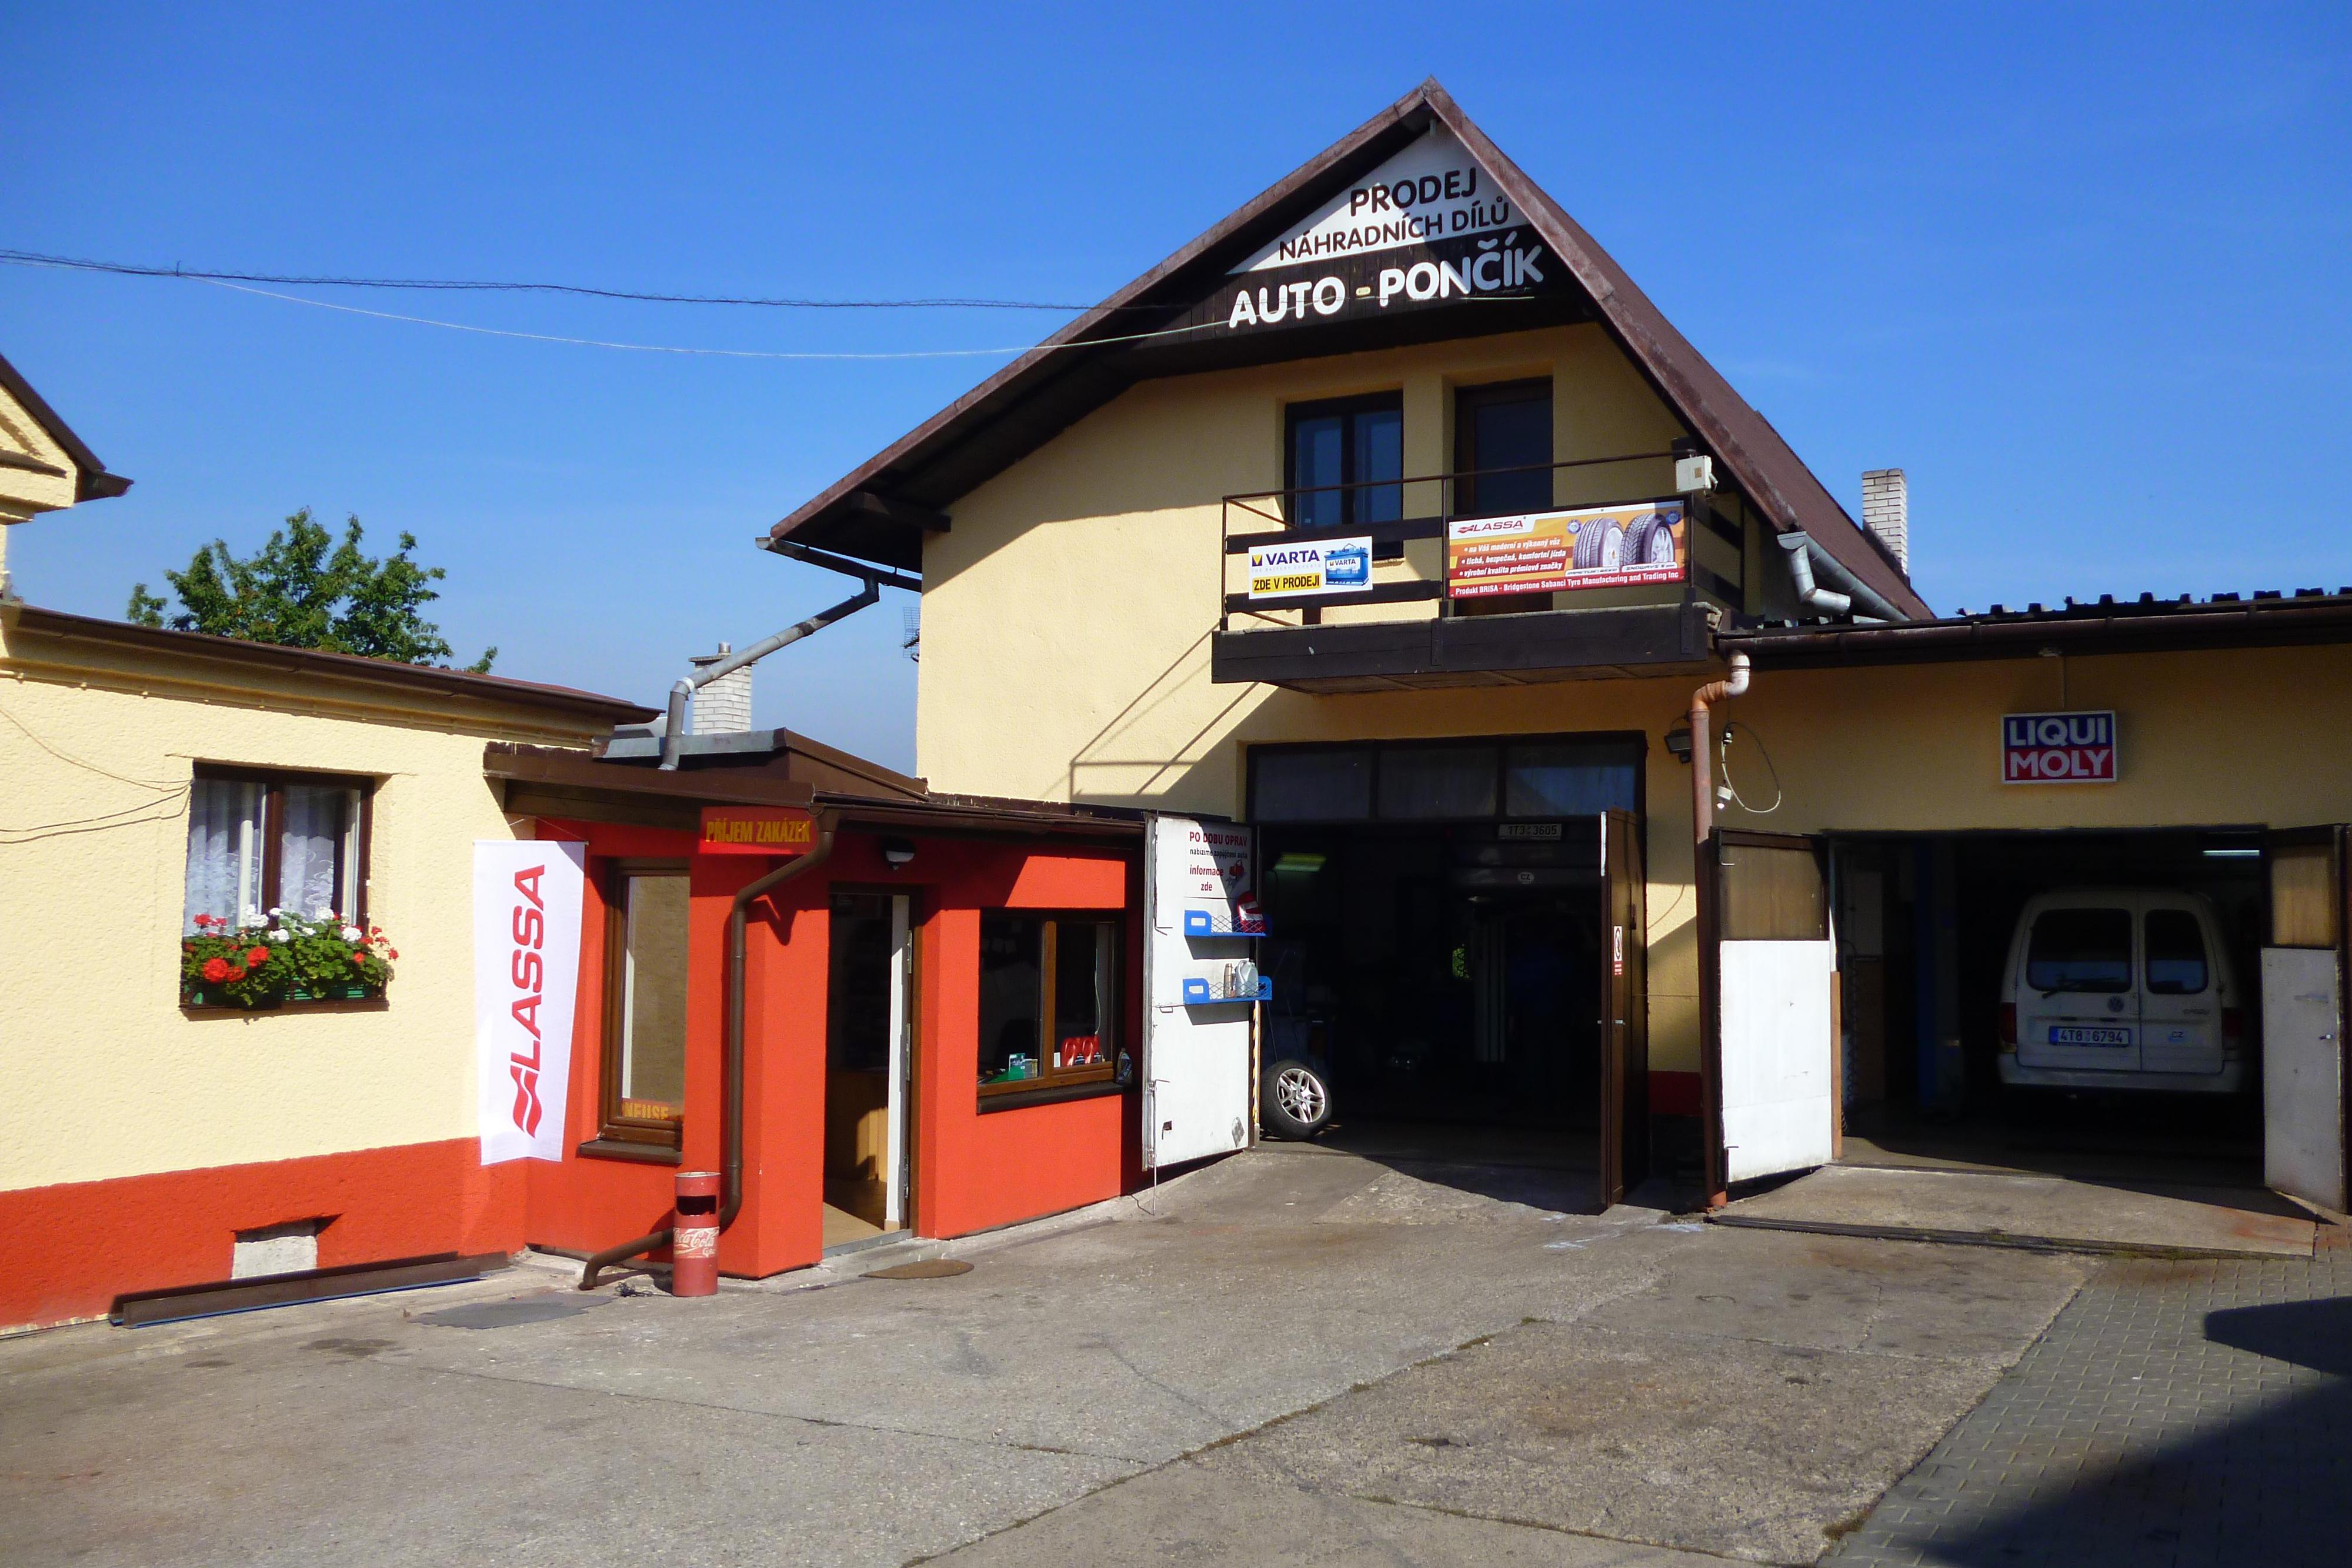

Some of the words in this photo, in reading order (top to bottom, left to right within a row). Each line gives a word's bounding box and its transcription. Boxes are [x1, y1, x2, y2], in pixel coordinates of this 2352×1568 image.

[1350, 168, 1477, 216] PRODEJ
[1279, 212, 1443, 261] NÁHRADNÍCH
[1452, 196, 1510, 232] DÍLŮ
[1229, 276, 1346, 328] AUTO
[1379, 231, 1544, 307] PONČÍK
[1473, 520, 1523, 532] LASSA
[1478, 543, 1490, 552] Váš
[1490, 541, 1516, 551] moderní
[1522, 538, 1548, 549] výkonný
[1266, 549, 1320, 565] VARTA
[1518, 550, 1550, 560] komfortní
[1550, 549, 1566, 559] jízda
[1464, 567, 1486, 578] výrobní
[1487, 565, 1509, 575] kvalita
[1510, 563, 1539, 574] prémiové
[1540, 561, 1563, 571] značky
[1254, 578, 1271, 591] ZDE
[1273, 578, 1280, 589] V
[1283, 575, 1320, 589] PRODEJI
[1456, 586, 1478, 595] Produkt
[1479, 585, 1498, 593] BRISA
[1503, 582, 1540, 591] Bridgestone
[1541, 580, 1566, 588] Sabanci
[1567, 578, 1580, 587] Tyre
[1582, 575, 1627, 585] Manufacturing
[1629, 573, 1641, 581] and
[1643, 572, 1667, 581] Trading
[2009, 717, 2107, 746] LIQUI
[2010, 749, 2110, 778] MOLY
[706, 818, 753, 842] PŘÍJEM
[756, 817, 811, 842] ZAKÁZEK
[1508, 825, 1525, 835] 1T3
[1533, 825, 1557, 835] 3605
[1189, 831, 1200, 842] PO
[1203, 832, 1223, 845] DOBU
[1225, 834, 1247, 847] OPRAV
[1190, 865, 1224, 877] informace
[1200, 881, 1213, 891] zde
[511, 864, 545, 1072] LASSA
[2060, 1029, 2083, 1042] 4T8
[2093, 1029, 2124, 1043] 6794
